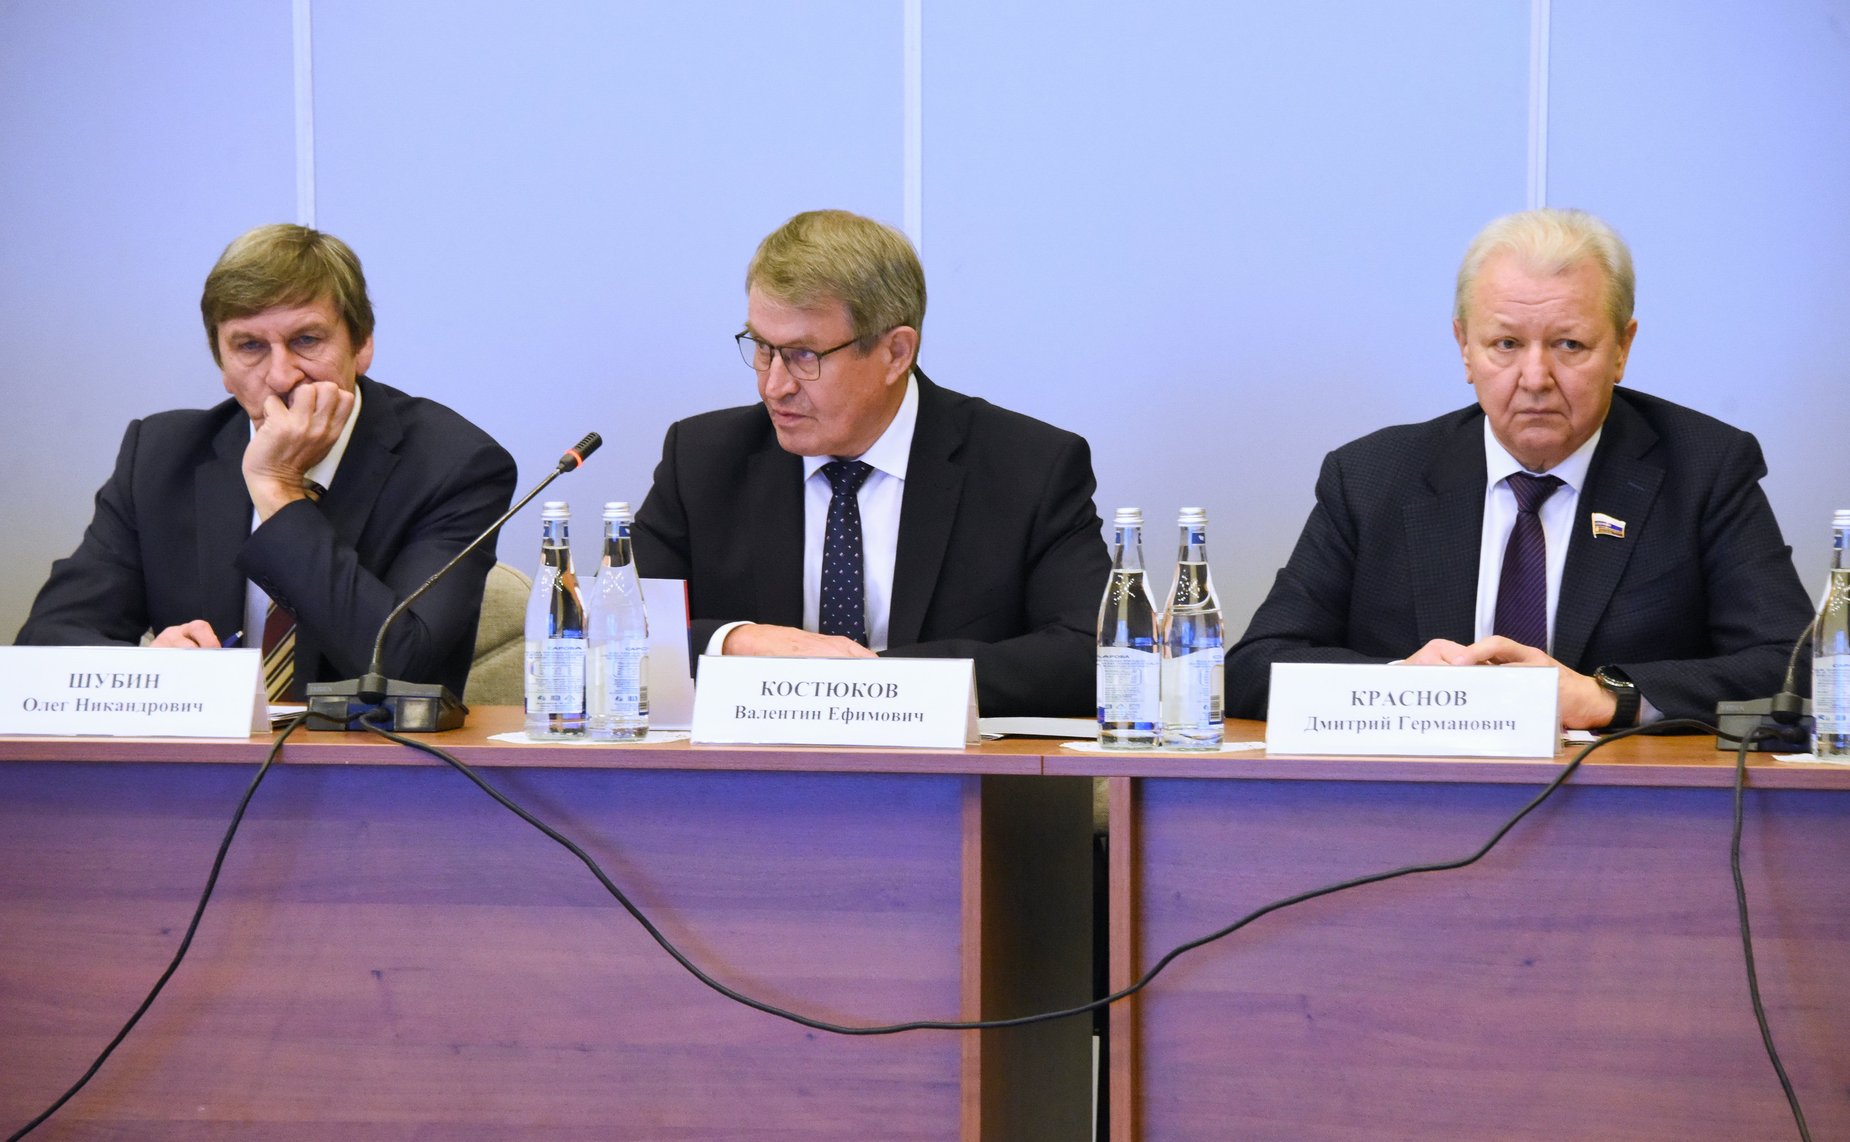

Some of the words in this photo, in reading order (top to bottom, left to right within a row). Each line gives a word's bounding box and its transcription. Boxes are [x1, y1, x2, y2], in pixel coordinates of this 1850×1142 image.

[68, 673, 160, 689] ШУБИН
[761, 680, 899, 699] КОСТЮКОВ
[22, 697, 69, 712] Олег
[75, 697, 203, 716] Никандрович
[1351, 690, 1468, 707] КРАСНОВ
[735, 705, 822, 721] Валентин
[828, 706, 924, 725] Ефимович
[1304, 716, 1391, 734] Дмитрий
[1398, 716, 1517, 734] Германович
